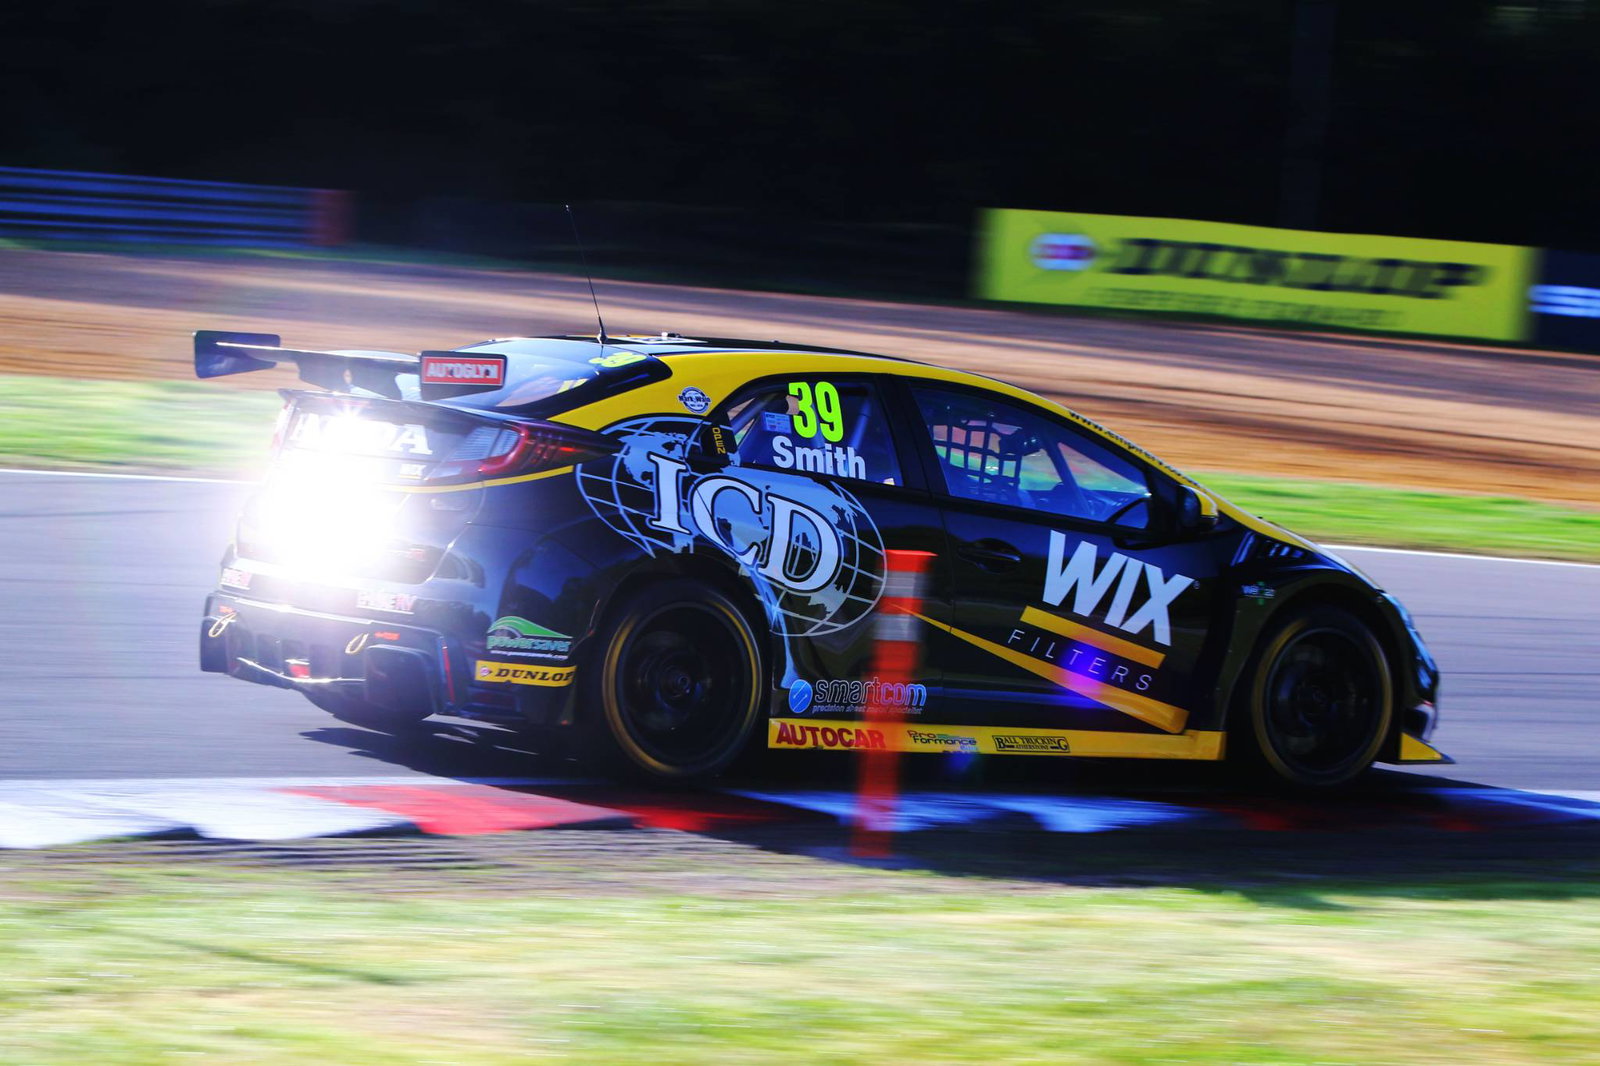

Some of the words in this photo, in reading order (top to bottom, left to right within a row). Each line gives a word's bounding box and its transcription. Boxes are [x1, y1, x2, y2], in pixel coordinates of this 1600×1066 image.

[788, 381, 844, 443] 39
[712, 427, 727, 455] OPEN
[772, 435, 867, 480] Smith
[648, 452, 841, 593] ICD
[1042, 529, 1195, 647] WIX
[1008, 629, 1152, 691] FILTERS
[812, 703, 844, 714] precision
[815, 676, 927, 707] smartcom
[776, 721, 886, 749] AUTOCAR
[995, 737, 1019, 749] BALL
[1020, 737, 1068, 751] TRUCKING
